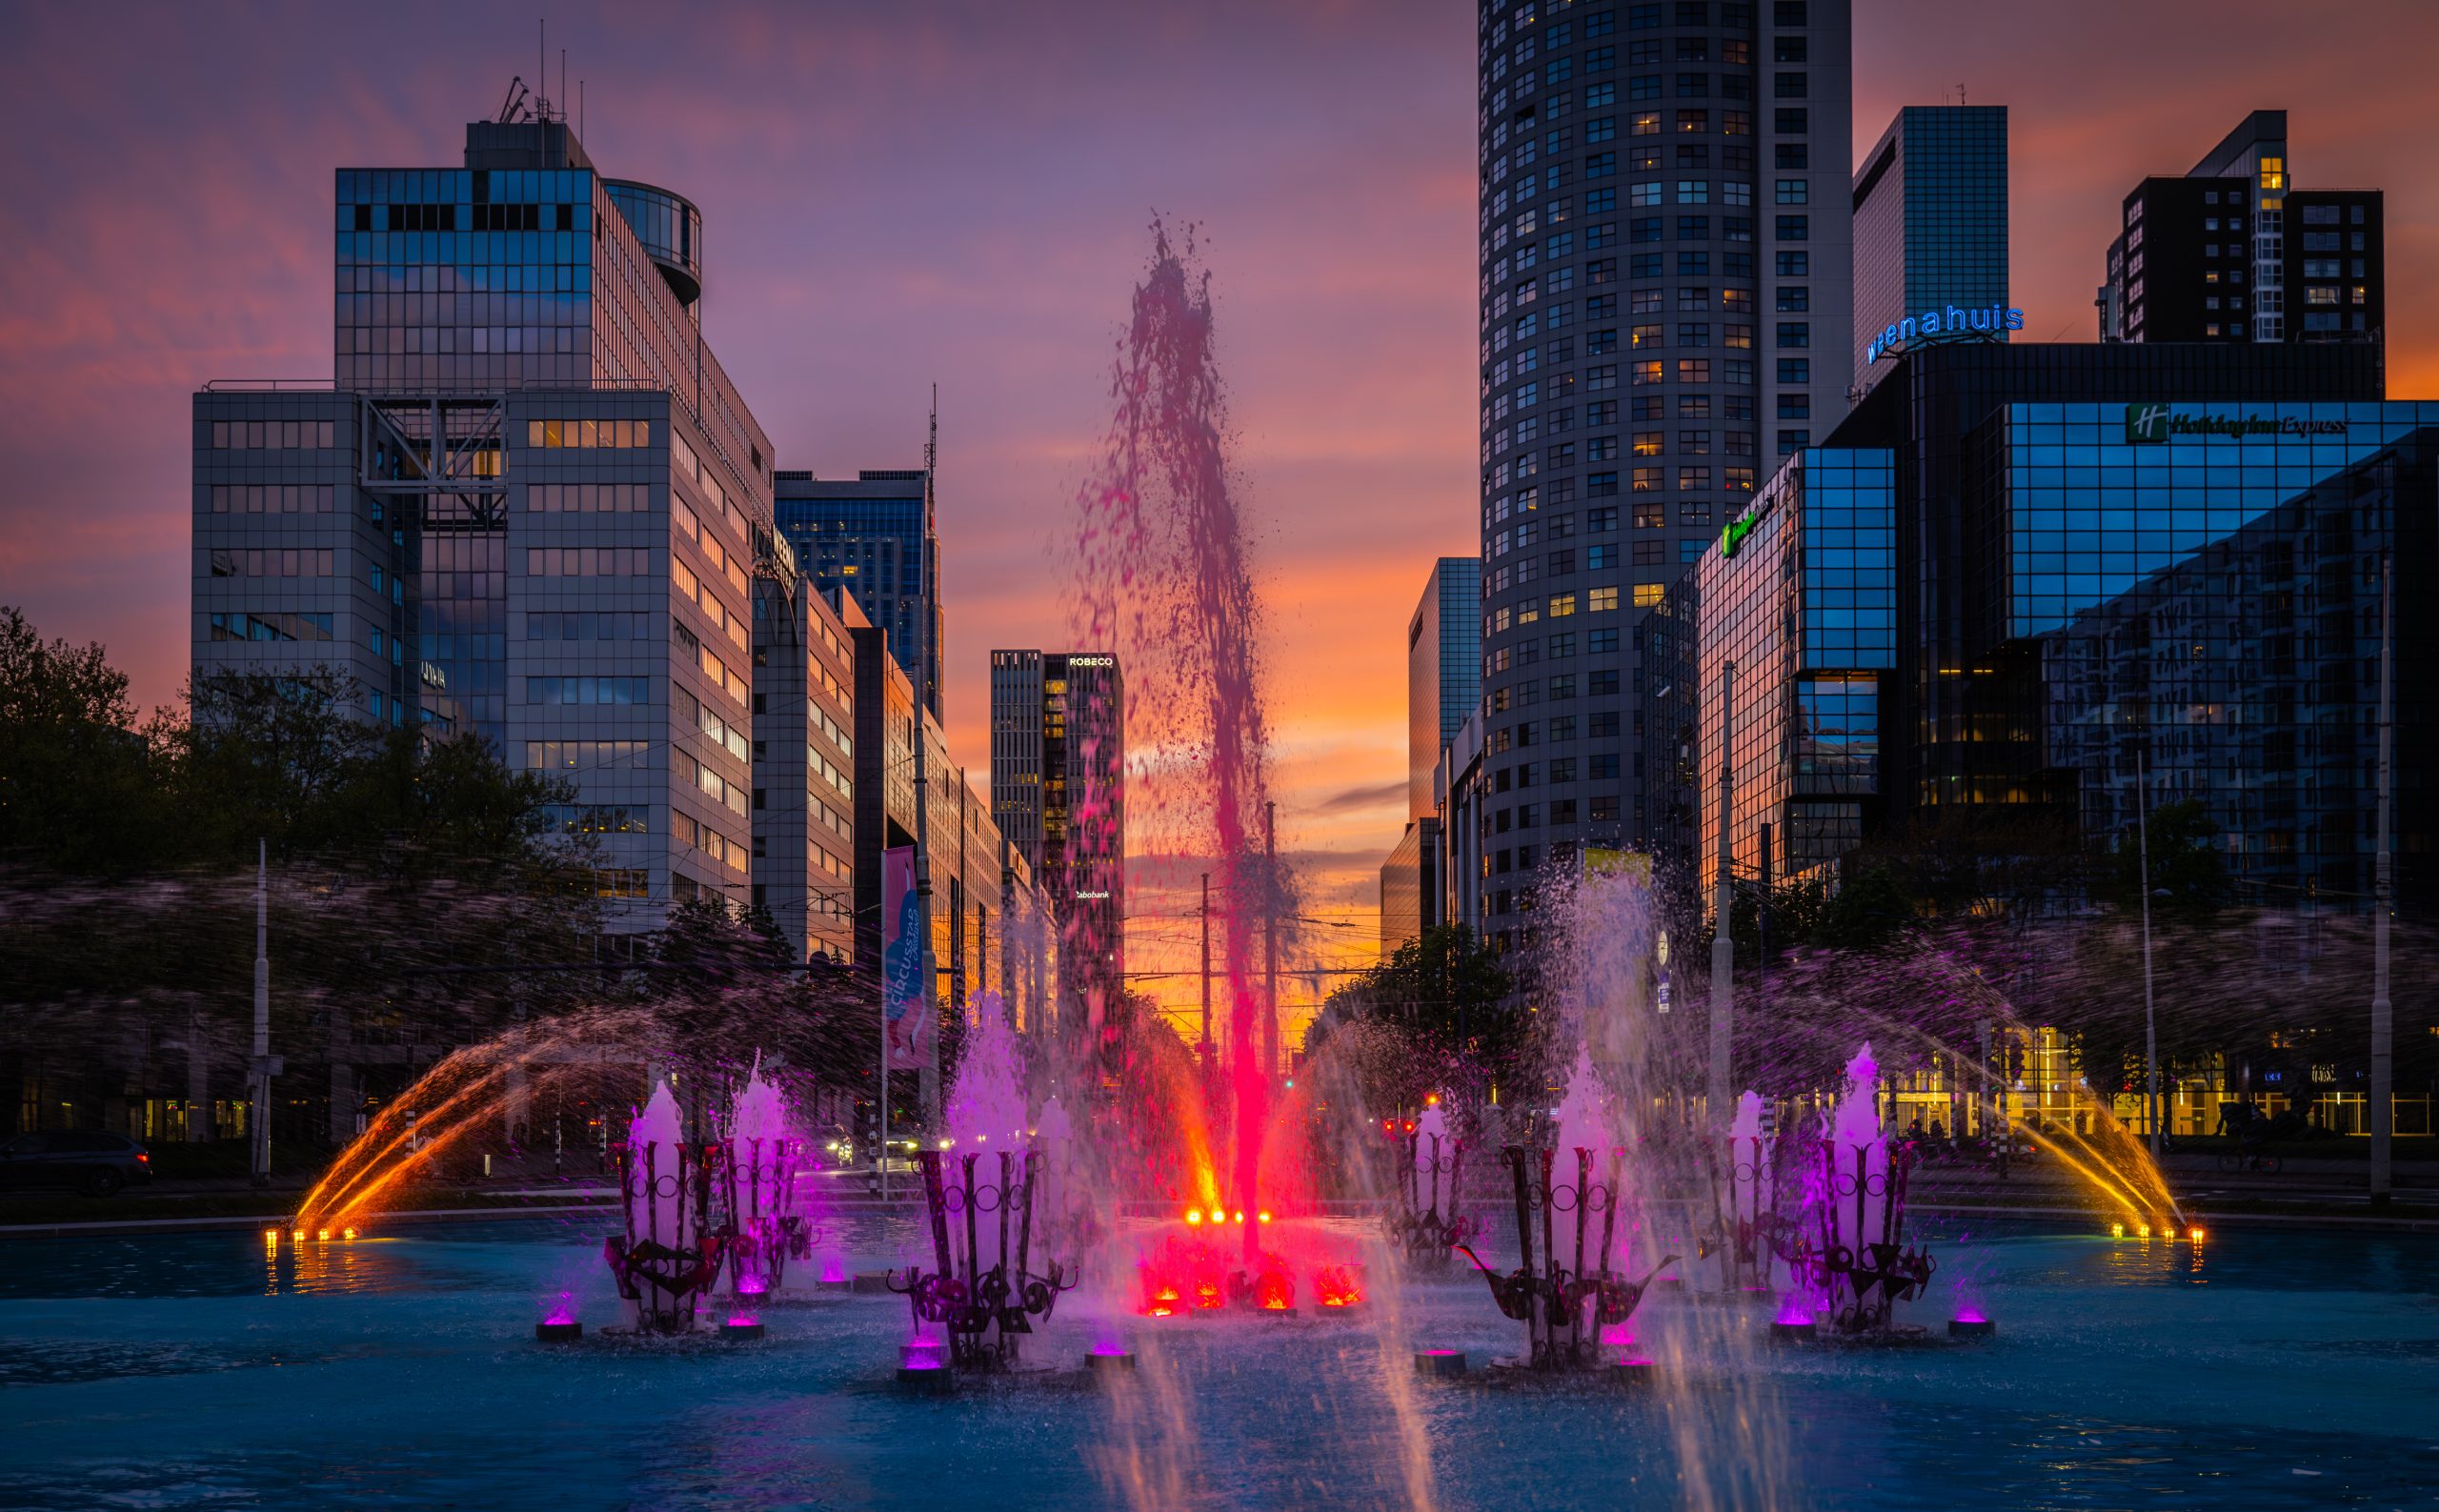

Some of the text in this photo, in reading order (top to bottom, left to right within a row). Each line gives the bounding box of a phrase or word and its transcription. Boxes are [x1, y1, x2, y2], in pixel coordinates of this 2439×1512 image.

[1866, 304, 2024, 365] weenahuis
[2284, 415, 2348, 437] Express
[1069, 657, 1113, 666] ROBECO
